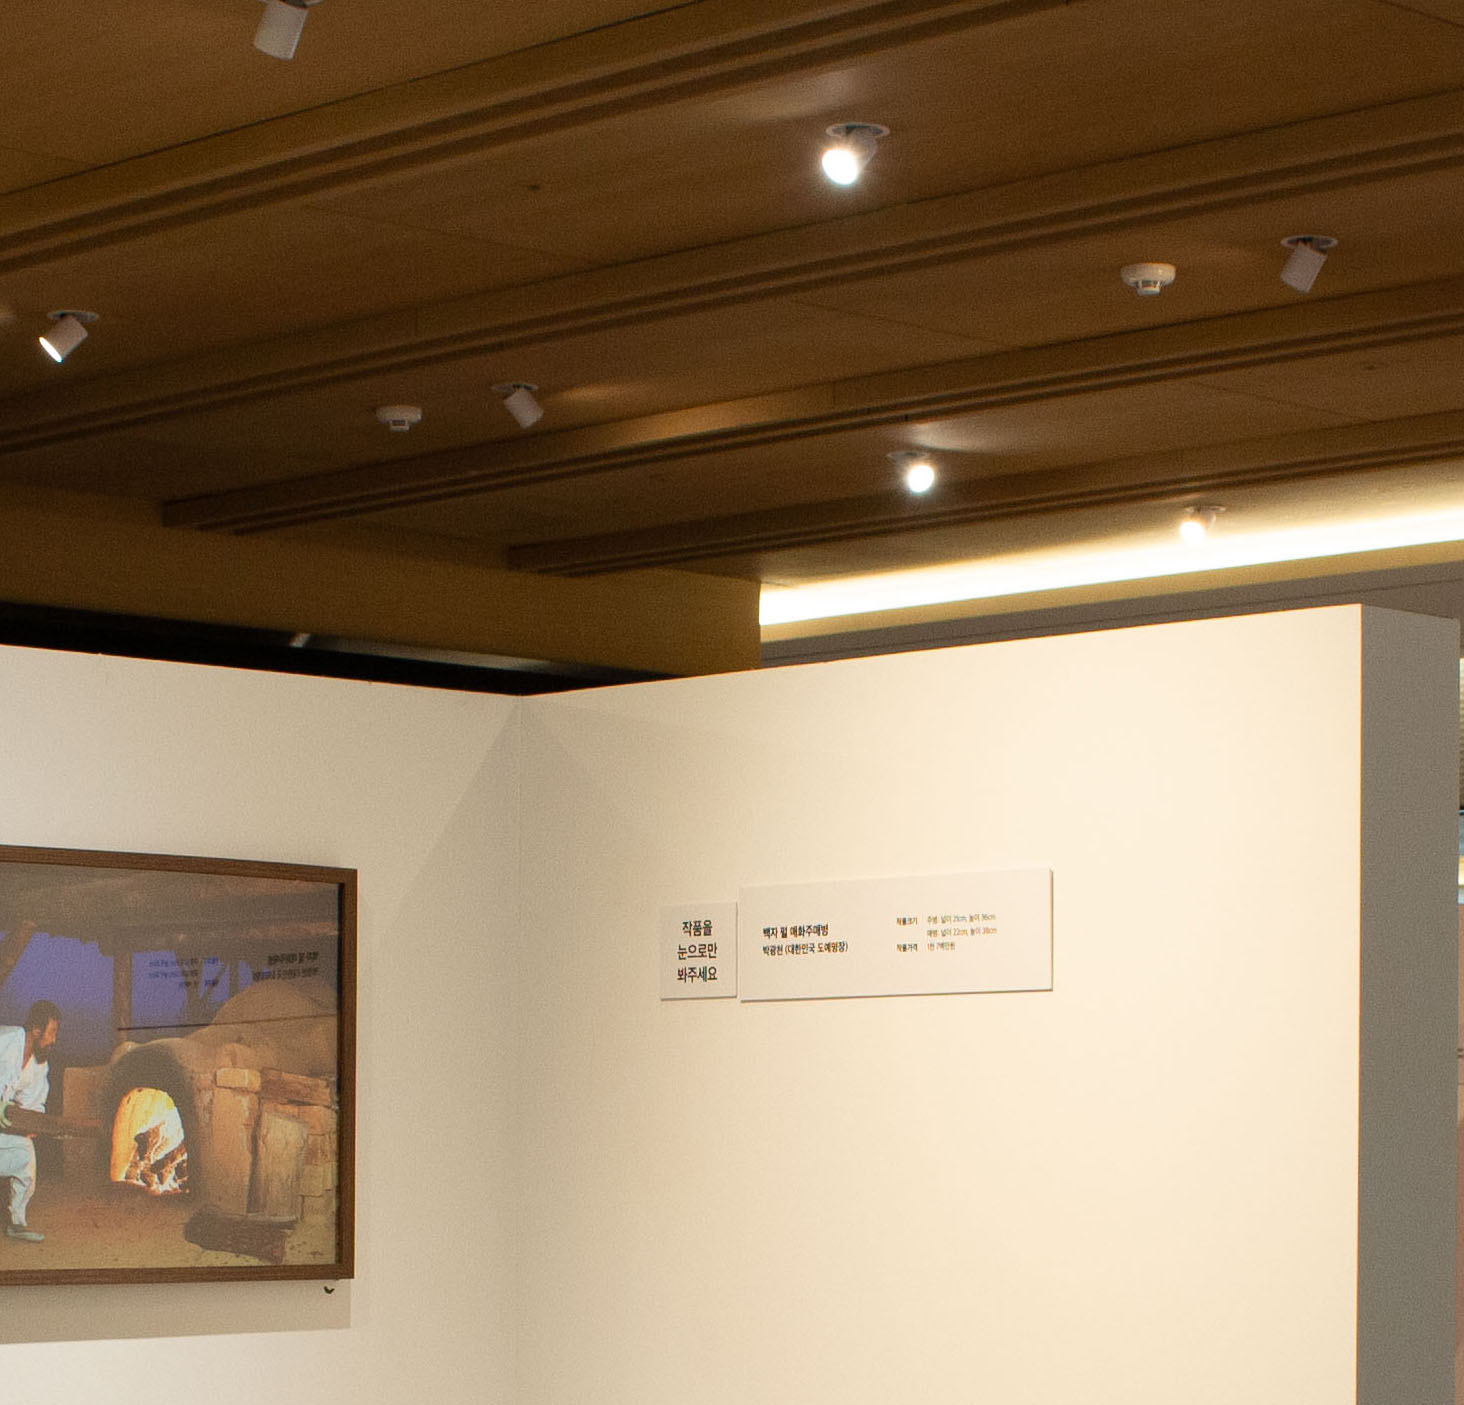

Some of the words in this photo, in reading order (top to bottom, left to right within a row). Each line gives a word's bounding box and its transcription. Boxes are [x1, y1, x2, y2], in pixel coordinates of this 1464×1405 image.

[682, 919, 713, 937] 작품을
[762, 926, 778, 939] 백자
[676, 942, 718, 960] 눈으로만
[784, 942, 816, 955] (대한민국
[676, 966, 718, 983] 봐주세요
